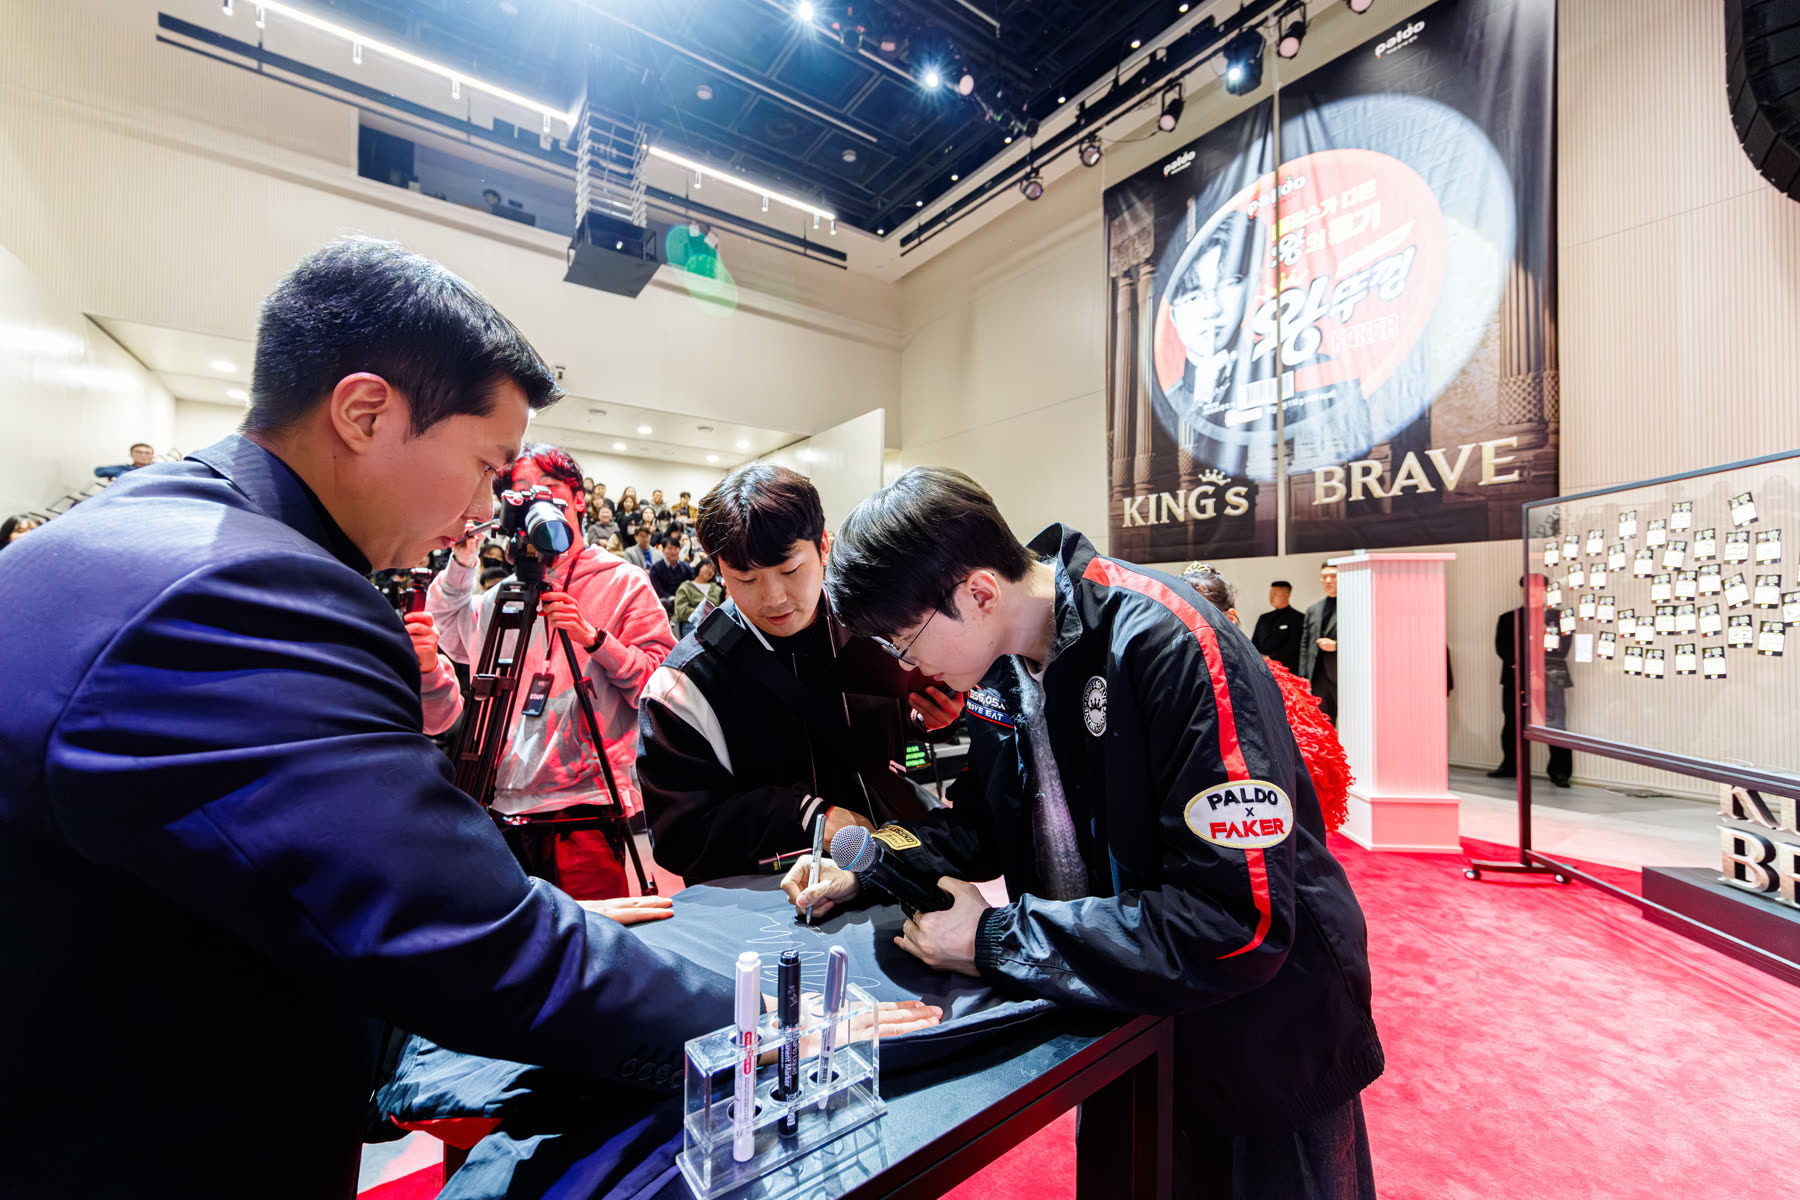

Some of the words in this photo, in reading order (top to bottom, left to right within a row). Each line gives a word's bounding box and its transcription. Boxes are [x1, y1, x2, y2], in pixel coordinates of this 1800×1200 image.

[1375, 21, 1425, 58] paldo
[1248, 176, 1306, 218] paldo
[1312, 436, 1520, 505] BRAVE
[1206, 787, 1278, 811] PALDO
[1209, 817, 1286, 840] FAKER
[784, 1063, 792, 1087] Marker
